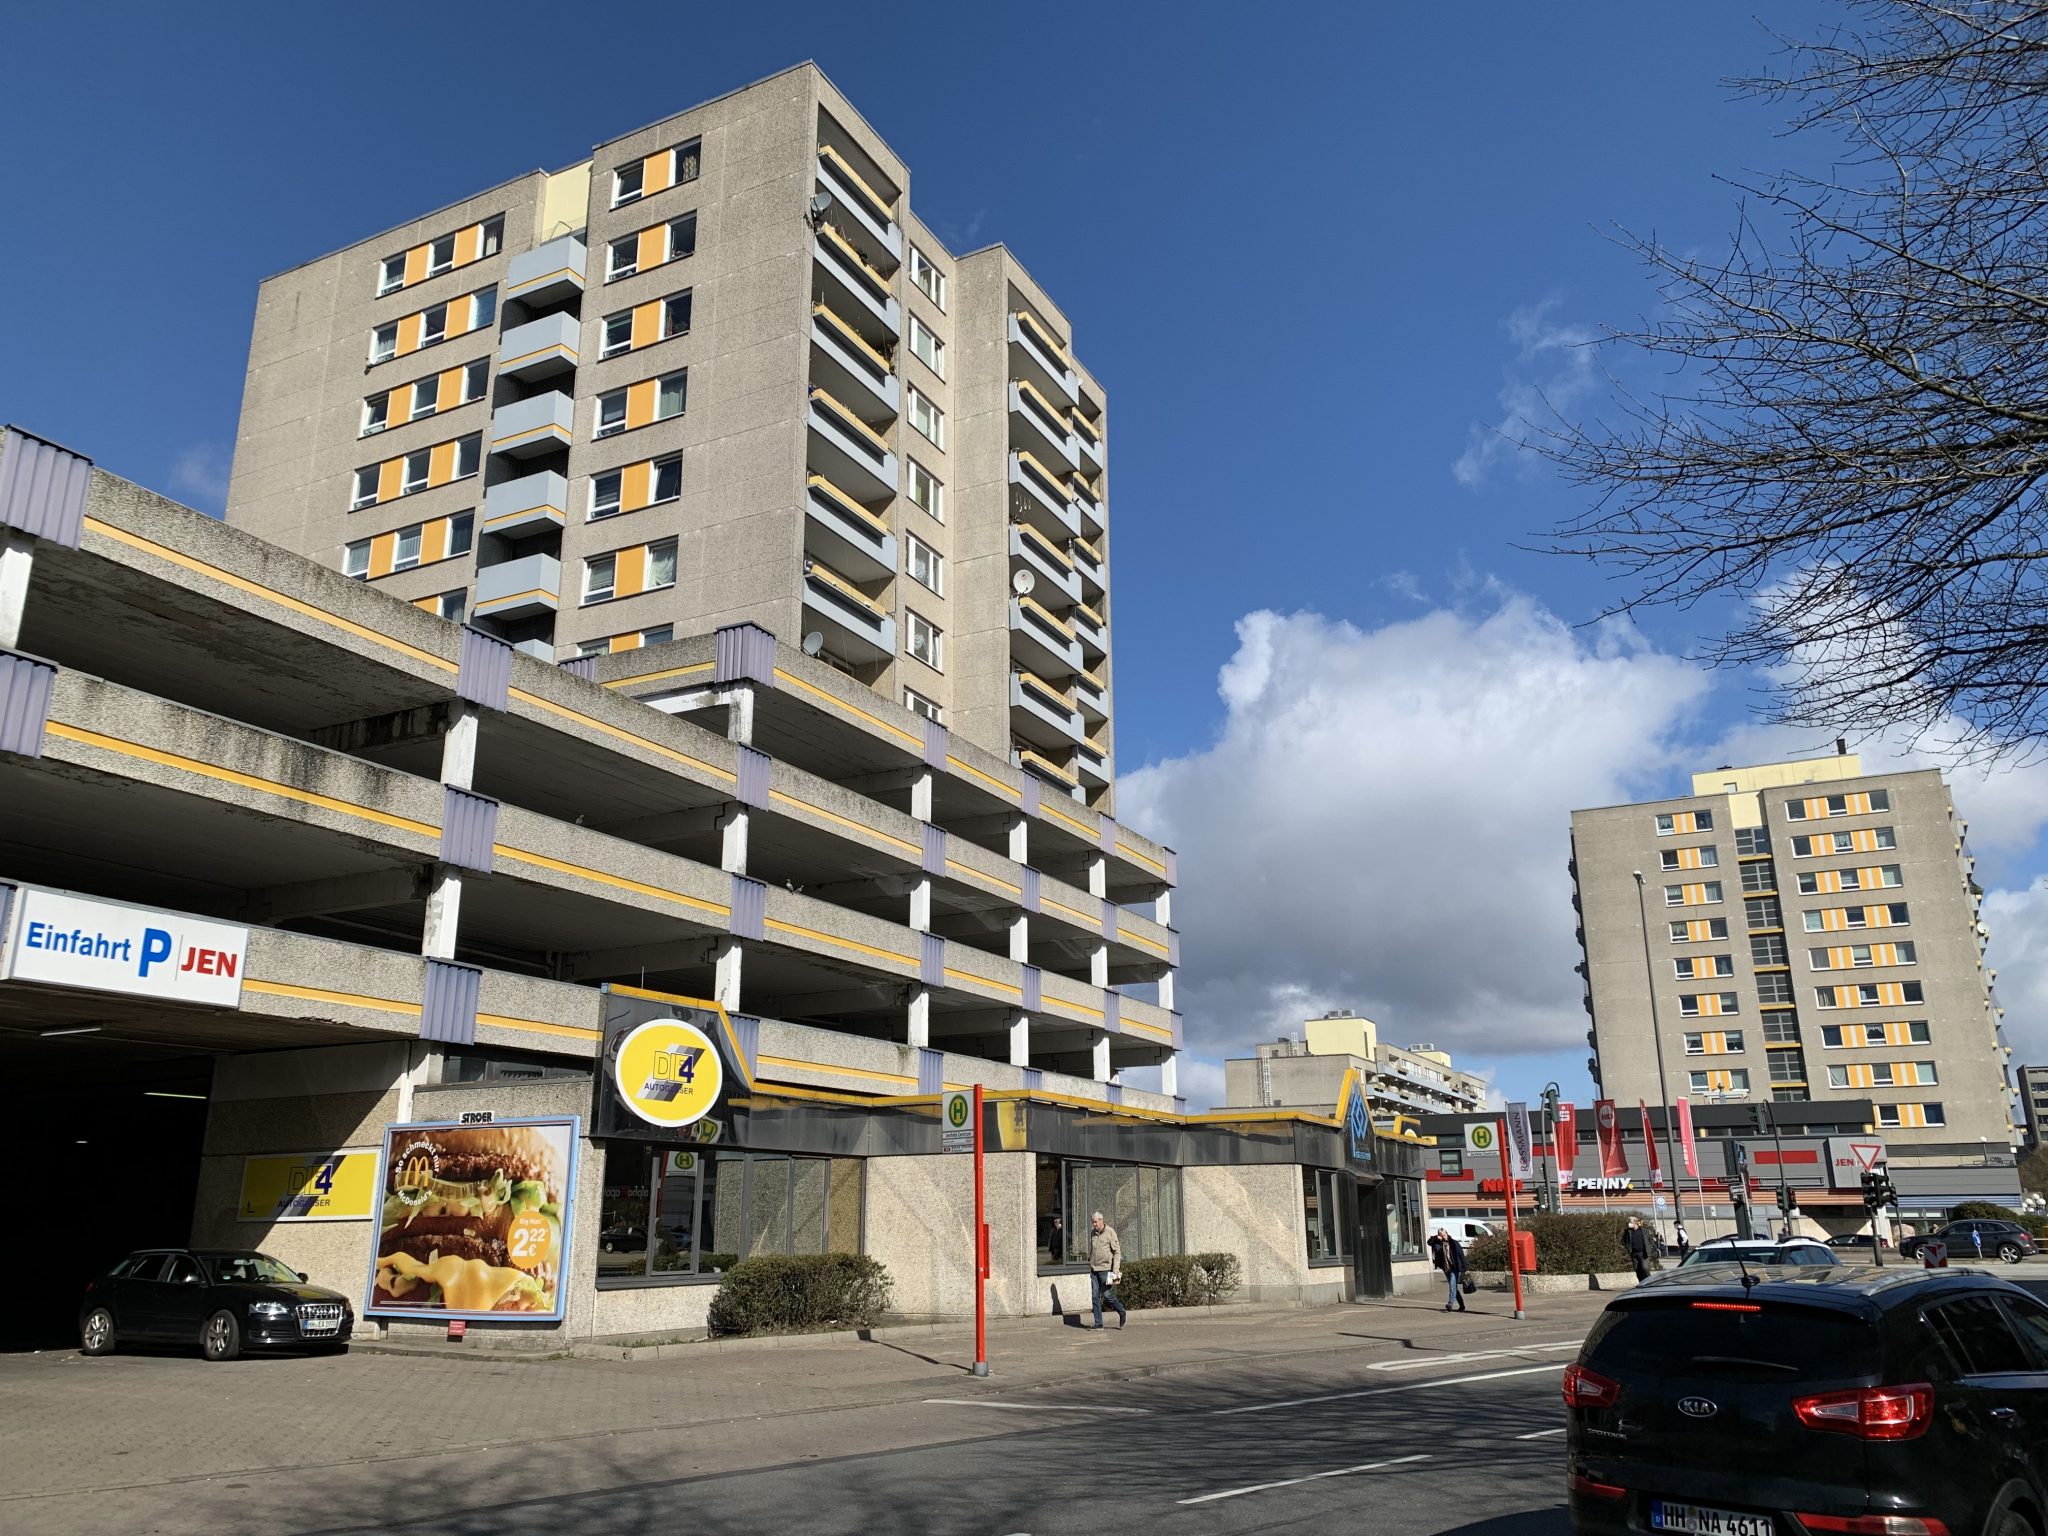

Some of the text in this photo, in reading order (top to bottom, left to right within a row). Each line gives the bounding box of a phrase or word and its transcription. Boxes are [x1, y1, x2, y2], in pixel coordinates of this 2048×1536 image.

[26, 921, 238, 978] Einfahrt P JEN
[643, 1082, 694, 1096] AUTOGSER
[1514, 1111, 1529, 1172] ROSSMANN
[395, 1160, 404, 1173] So
[402, 1141, 436, 1159] schmeckt
[1836, 1158, 1855, 1167] JEN
[1684, 1401, 1711, 1413] KIA
[1664, 1505, 1686, 1528] HH
[1699, 1510, 1722, 1533] NA
